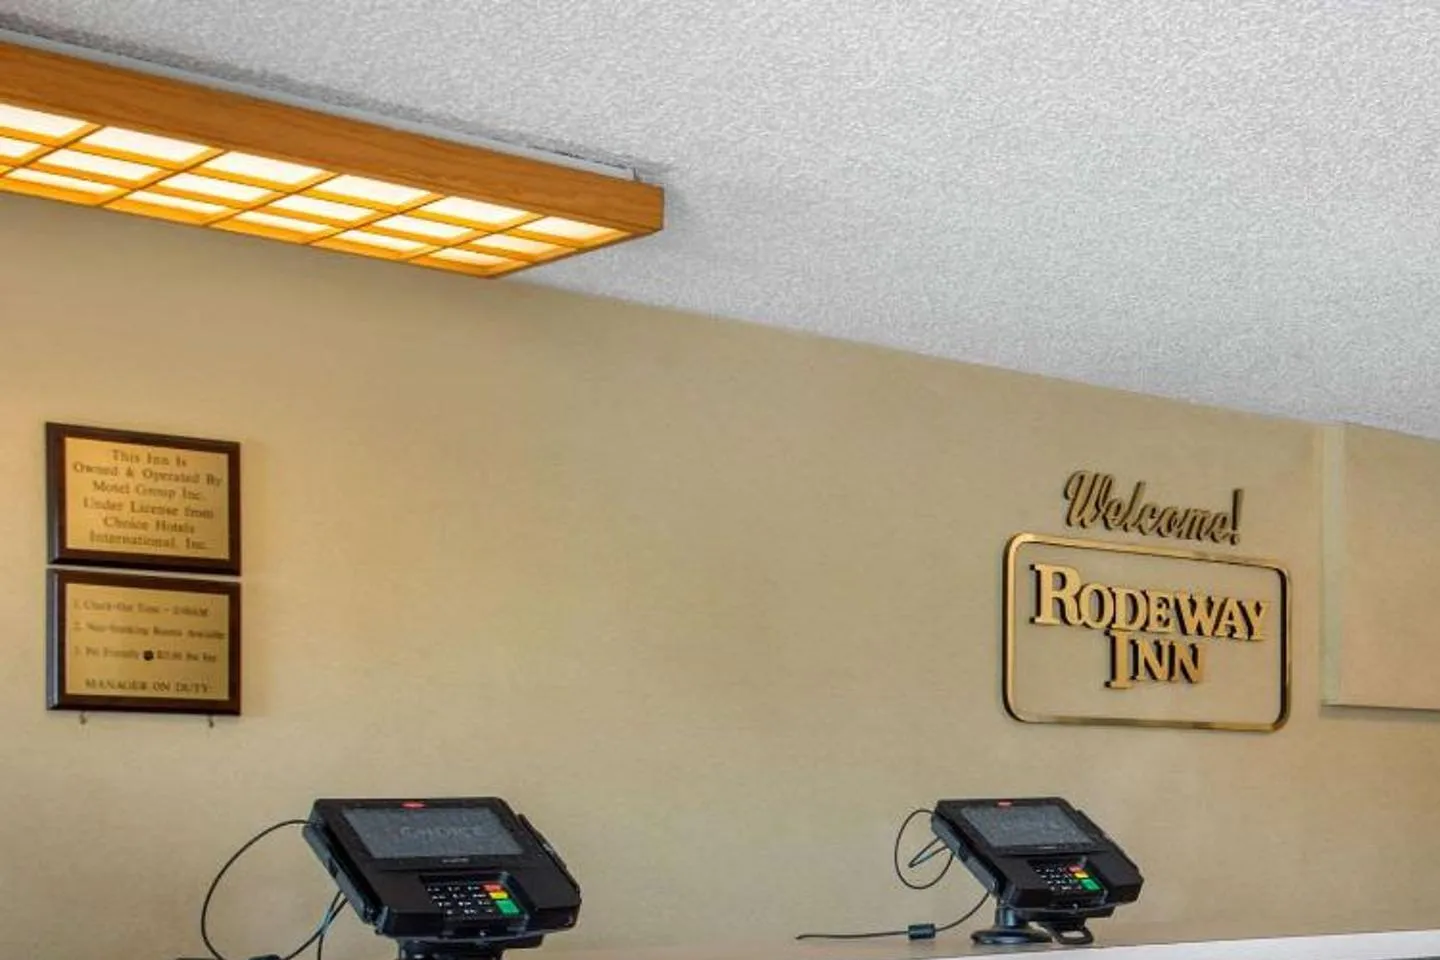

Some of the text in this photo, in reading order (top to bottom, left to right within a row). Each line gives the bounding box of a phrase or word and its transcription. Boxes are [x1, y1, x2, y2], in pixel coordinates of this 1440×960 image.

[112, 449, 140, 464] This
[147, 452, 170, 466] Inn
[73, 461, 118, 477] Owned
[142, 469, 201, 485] Operated
[206, 473, 223, 489] By
[135, 481, 175, 500] Group
[84, 496, 214, 520] Under License from
[1063, 470, 1244, 545] Welcome!
[104, 515, 195, 534] Choice Hotels
[1029, 563, 1271, 641] RODEWAY
[153, 681, 171, 692] ON
